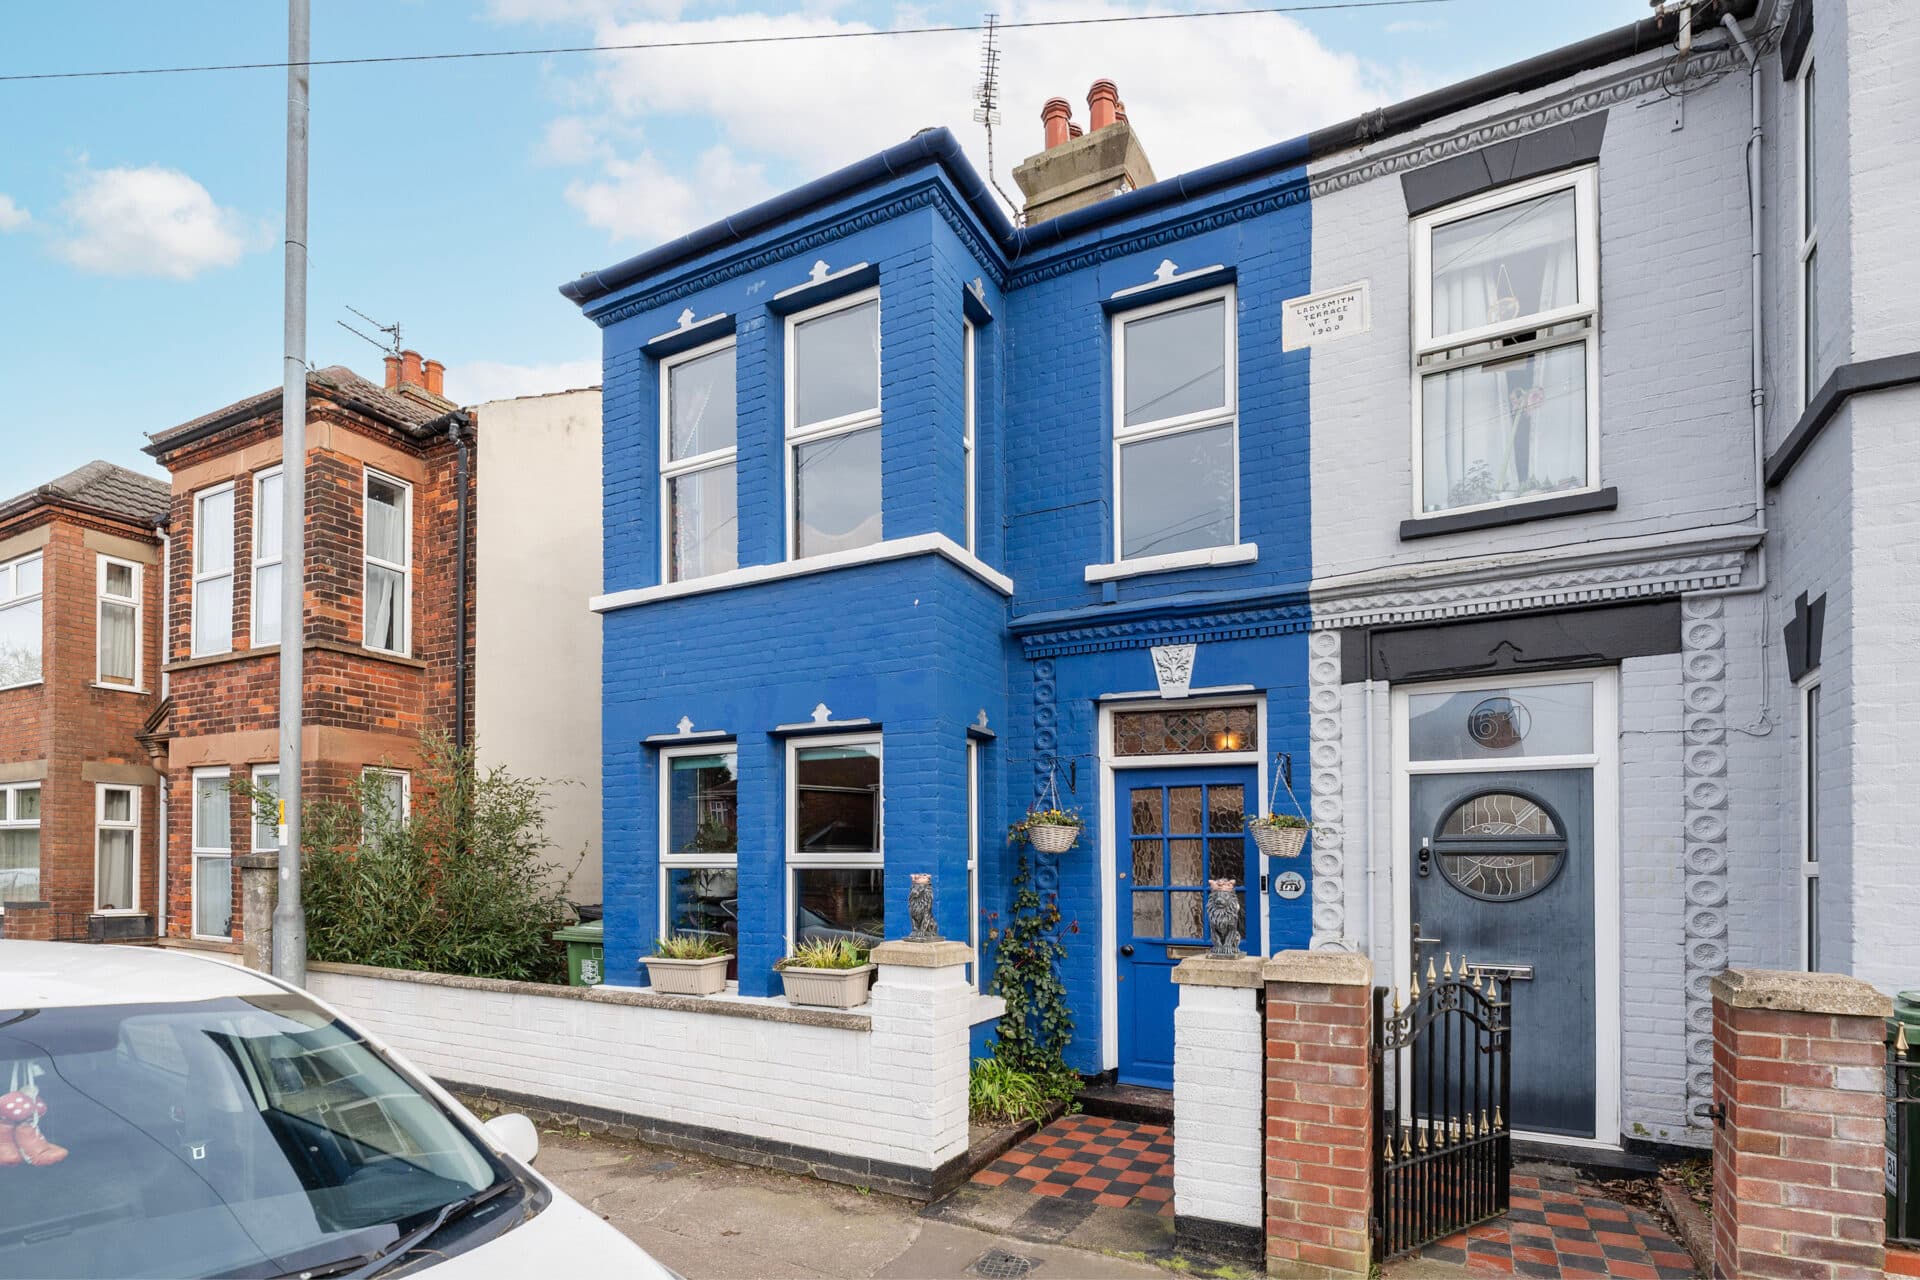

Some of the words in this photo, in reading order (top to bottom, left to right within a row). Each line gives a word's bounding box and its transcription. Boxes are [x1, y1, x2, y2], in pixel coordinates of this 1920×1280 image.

[1297, 296, 1354, 315] LADYSMITH
[1304, 305, 1348, 321] TERRACE
[1312, 324, 1340, 336] 1900
